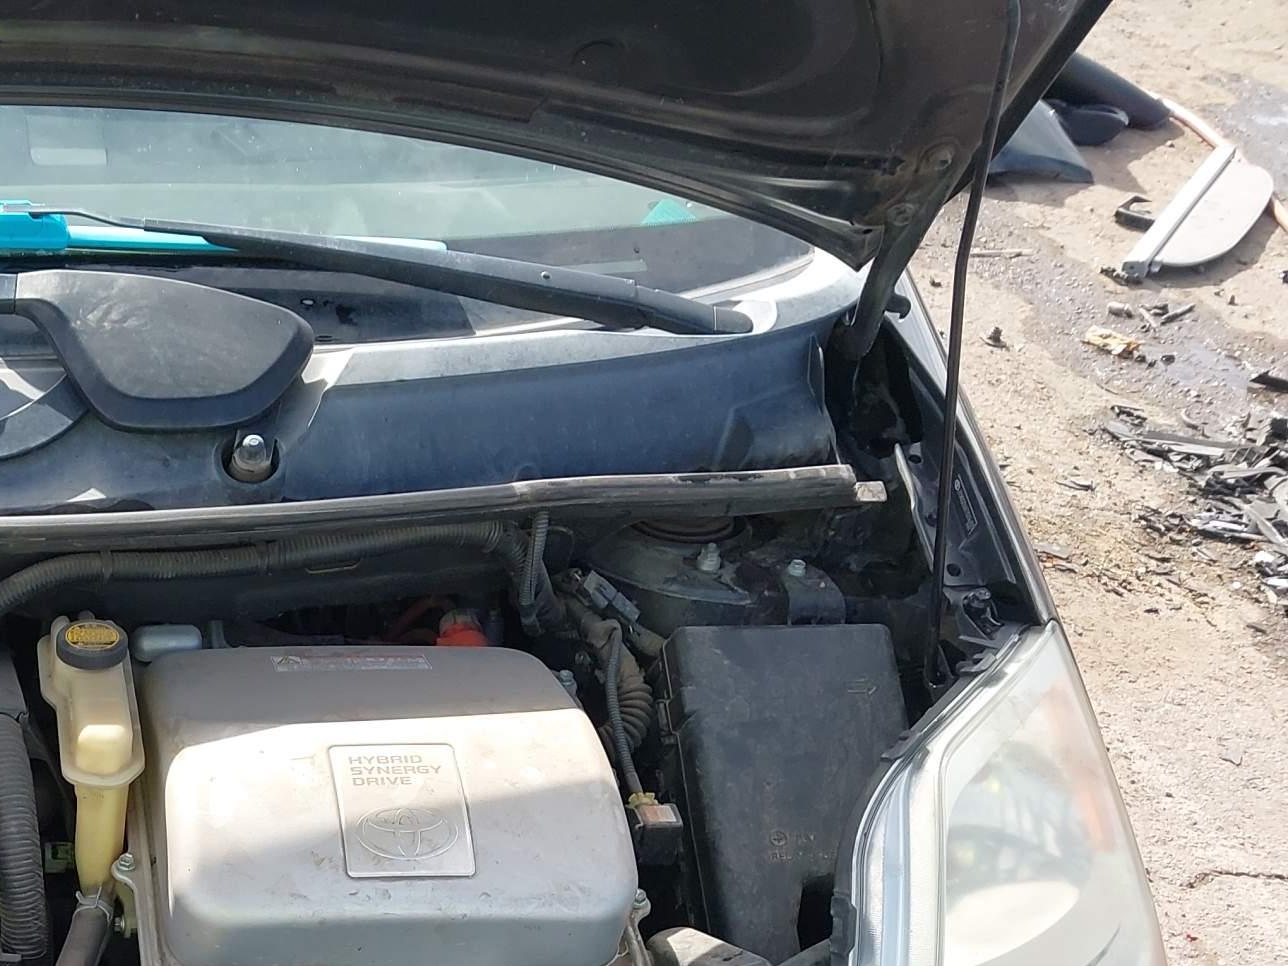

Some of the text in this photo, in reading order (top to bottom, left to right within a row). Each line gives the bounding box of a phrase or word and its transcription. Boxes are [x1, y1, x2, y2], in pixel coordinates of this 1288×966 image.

[348, 754, 423, 765] HYBRID
[350, 765, 441, 776] SYNERGY
[352, 776, 413, 786] DRIVE
